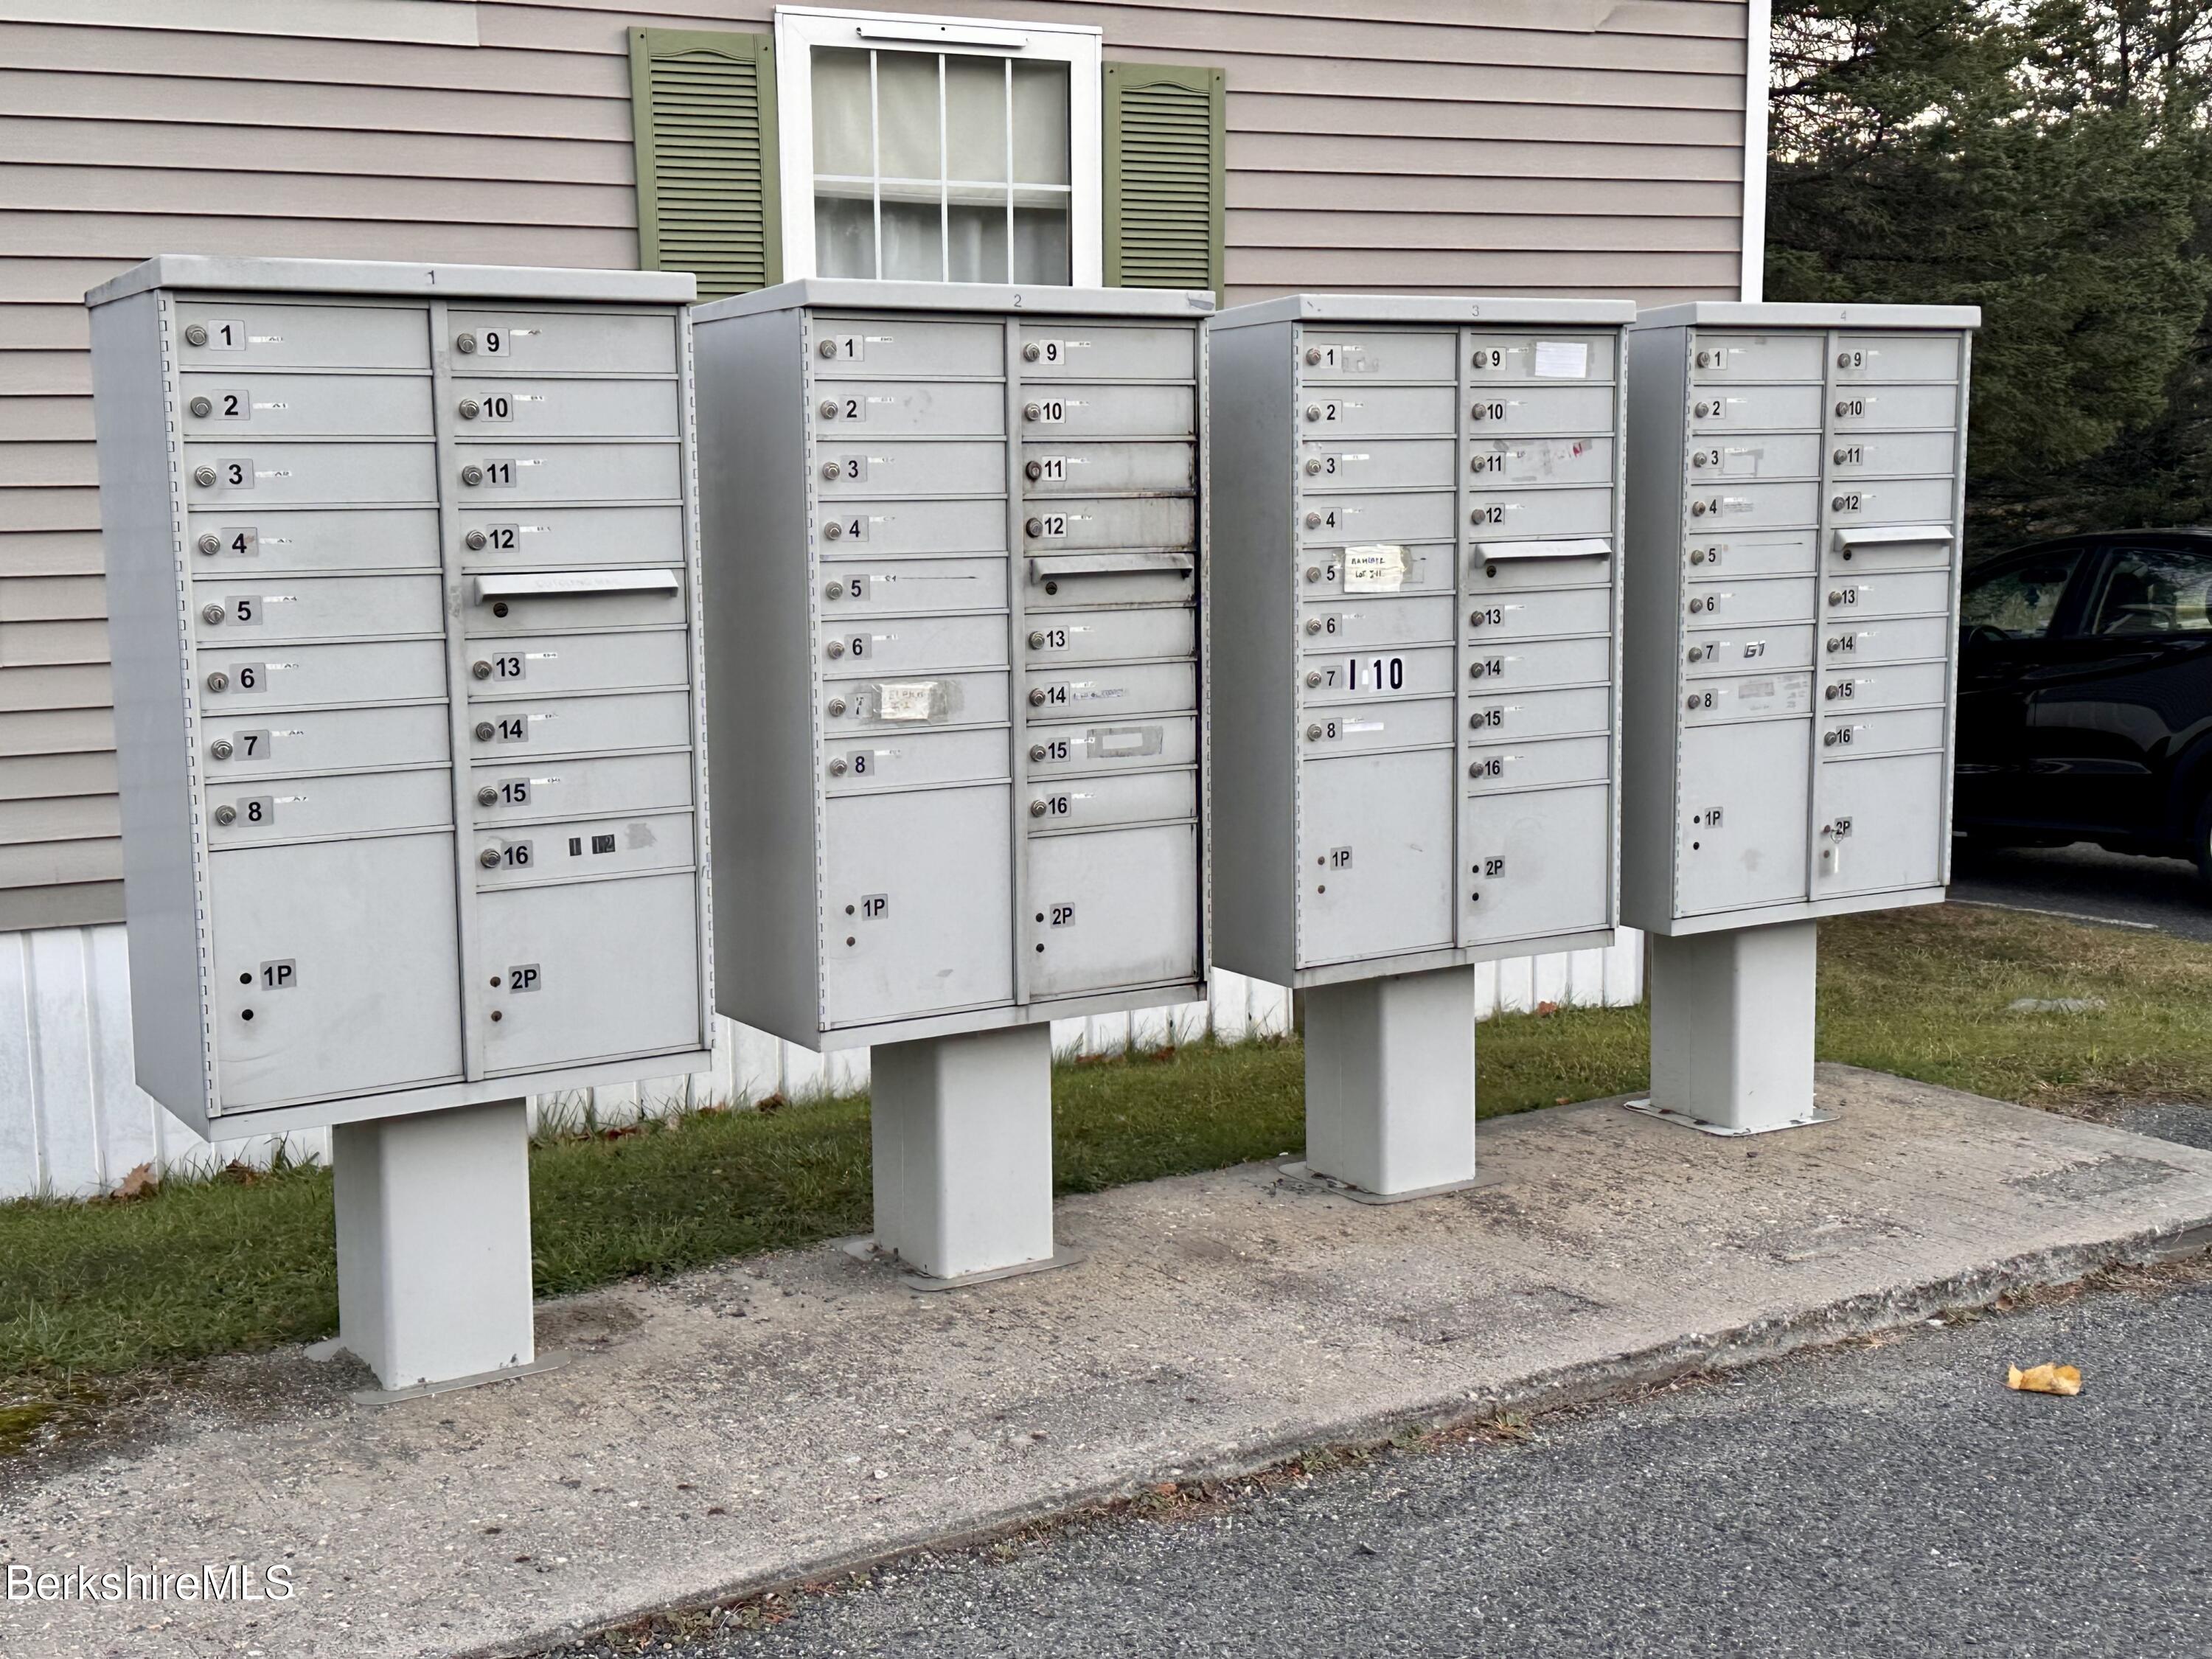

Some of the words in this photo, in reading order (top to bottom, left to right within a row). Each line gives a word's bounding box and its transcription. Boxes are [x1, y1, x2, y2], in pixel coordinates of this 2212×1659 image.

[427, 270, 435, 285] 1
[1014, 295, 1023, 307] 2
[1472, 305, 1480, 317] 3
[220, 324, 232, 346] 1
[487, 332, 500, 352] 9
[845, 338, 853, 358] 1
[1046, 343, 1057, 361] 9
[1326, 349, 1334, 366] 1
[1492, 350, 1500, 367] 9
[1714, 351, 1720, 366] 1
[1854, 352, 1862, 367] 9
[223, 394, 239, 416] 2
[483, 397, 508, 418] 10
[846, 400, 858, 418] 2
[1043, 402, 1062, 420] 10
[1326, 404, 1335, 420] 2
[1487, 403, 1503, 420] 10
[1712, 400, 1720, 416] 2
[1848, 400, 1863, 416] 10
[1486, 455, 1501, 472] 11
[1711, 450, 1719, 465] 3
[1847, 448, 1860, 463] 11
[487, 463, 509, 484] 11
[848, 460, 859, 479] 3
[1044, 460, 1062, 478] 11
[1326, 457, 1335, 474] 3
[229, 464, 243, 485] 3
[1709, 499, 1717, 514] 4
[1845, 495, 1859, 510] 12
[1326, 512, 1335, 528] 4
[1486, 507, 1502, 524] 12
[849, 519, 860, 538] 4
[1044, 517, 1064, 535] 12
[232, 533, 248, 554] 4
[489, 529, 515, 549] 12
[1708, 548, 1716, 563] 5
[1326, 565, 1335, 581] 5
[851, 580, 862, 598] 5
[1842, 589, 1855, 605] 13
[237, 600, 251, 622] 5
[1706, 597, 1714, 611] 6
[1485, 608, 1501, 625] 13
[1326, 617, 1335, 634] 6
[852, 638, 863, 656] 6
[1046, 630, 1065, 648] 13
[1840, 636, 1854, 651] 14
[1705, 644, 1714, 659] 7
[496, 657, 521, 677] 13
[1373, 658, 1403, 689] 10
[1485, 659, 1501, 676] 14
[240, 668, 255, 689] 6
[1326, 670, 1335, 686] 7
[1047, 686, 1066, 704] 14
[1838, 683, 1852, 698] 15
[1704, 692, 1712, 708] 8
[1485, 710, 1501, 726] 15
[498, 719, 524, 740] 14
[1326, 722, 1336, 739] 8
[1836, 728, 1851, 743] 16
[243, 736, 258, 756] 7
[1048, 742, 1067, 759] 15
[855, 756, 866, 773] 8
[1484, 759, 1500, 776] 16
[501, 783, 526, 803] 15
[248, 801, 262, 822] 8
[1048, 796, 1068, 815] 16
[1705, 810, 1721, 826] 1P
[1836, 820, 1851, 835] 2P
[595, 835, 614, 853] 12
[504, 845, 529, 866] 16
[1332, 851, 1350, 867] 1P
[1486, 859, 1503, 876] 2P
[863, 898, 886, 917] 1P
[1052, 907, 1073, 925] 2P
[263, 965, 292, 987] 1P
[511, 969, 538, 990] 2P
